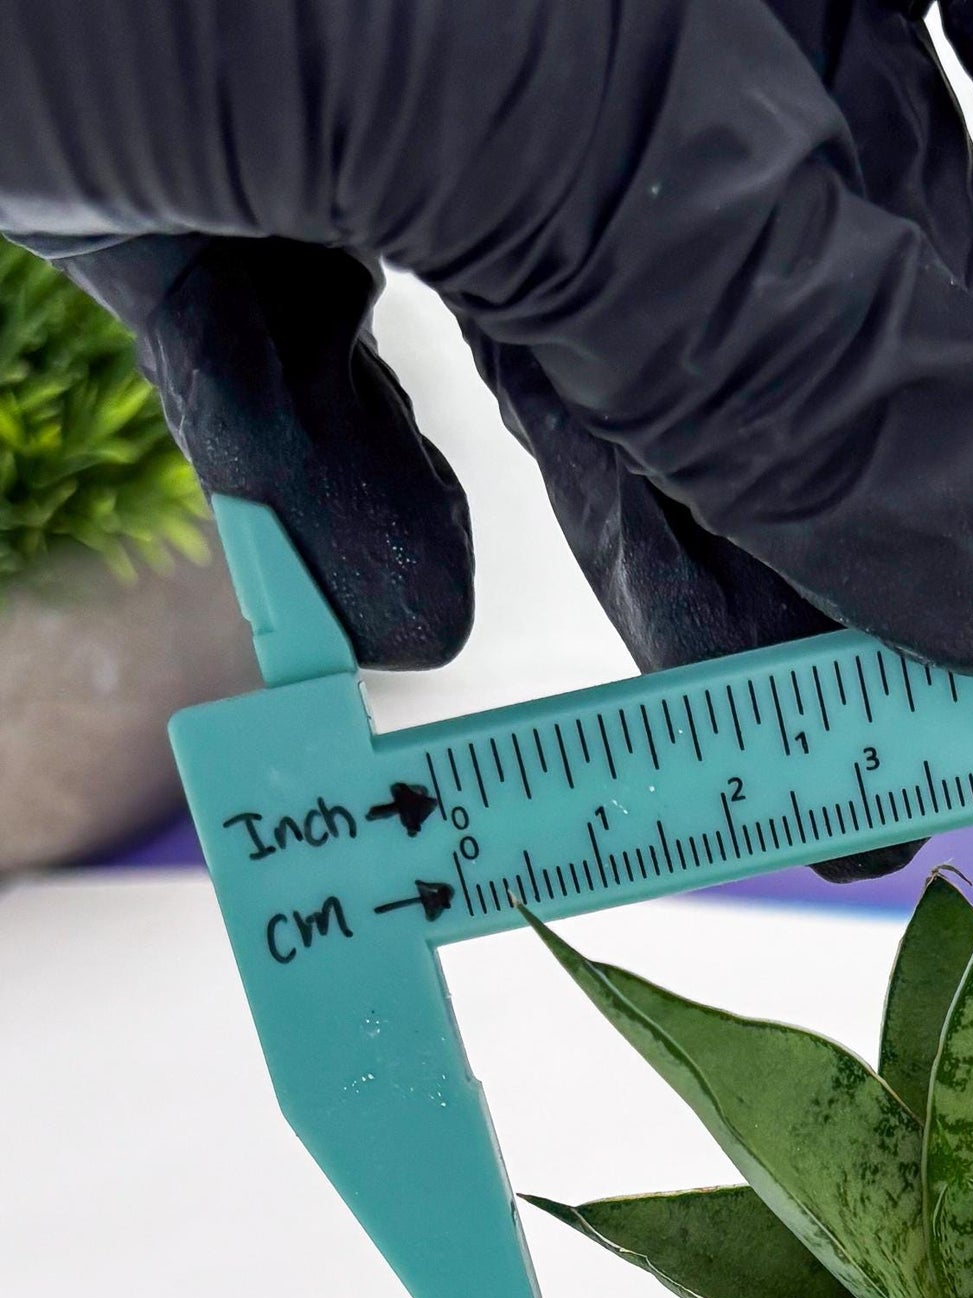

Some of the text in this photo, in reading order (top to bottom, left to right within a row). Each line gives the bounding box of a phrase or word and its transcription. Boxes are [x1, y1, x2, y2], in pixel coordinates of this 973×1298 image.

[222, 796, 358, 862] Inch
[450, 805, 470, 831] 0
[794, 730, 810, 755] 1
[458, 835, 480, 861] 0
[594, 805, 610, 831] 1
[727, 776, 747, 803] 2
[862, 746, 881, 772] 3
